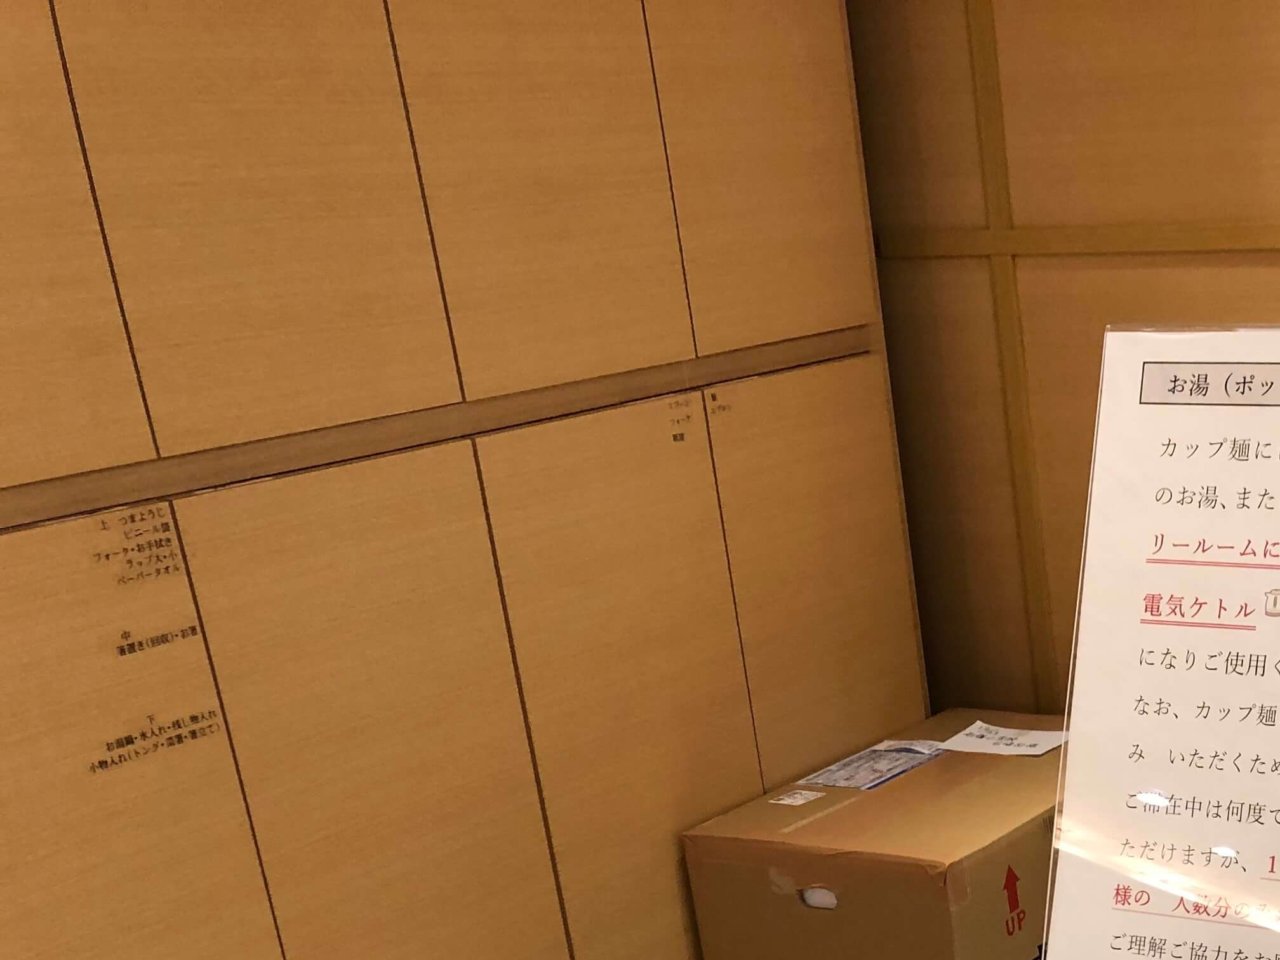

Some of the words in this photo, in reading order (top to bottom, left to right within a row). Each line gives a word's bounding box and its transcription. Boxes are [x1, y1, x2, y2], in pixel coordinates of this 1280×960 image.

[1141, 592, 1256, 621] 電気ケトル
[1127, 742, 1146, 763] み
[1114, 883, 1151, 907] 様の
[1005, 908, 1027, 937] UP
